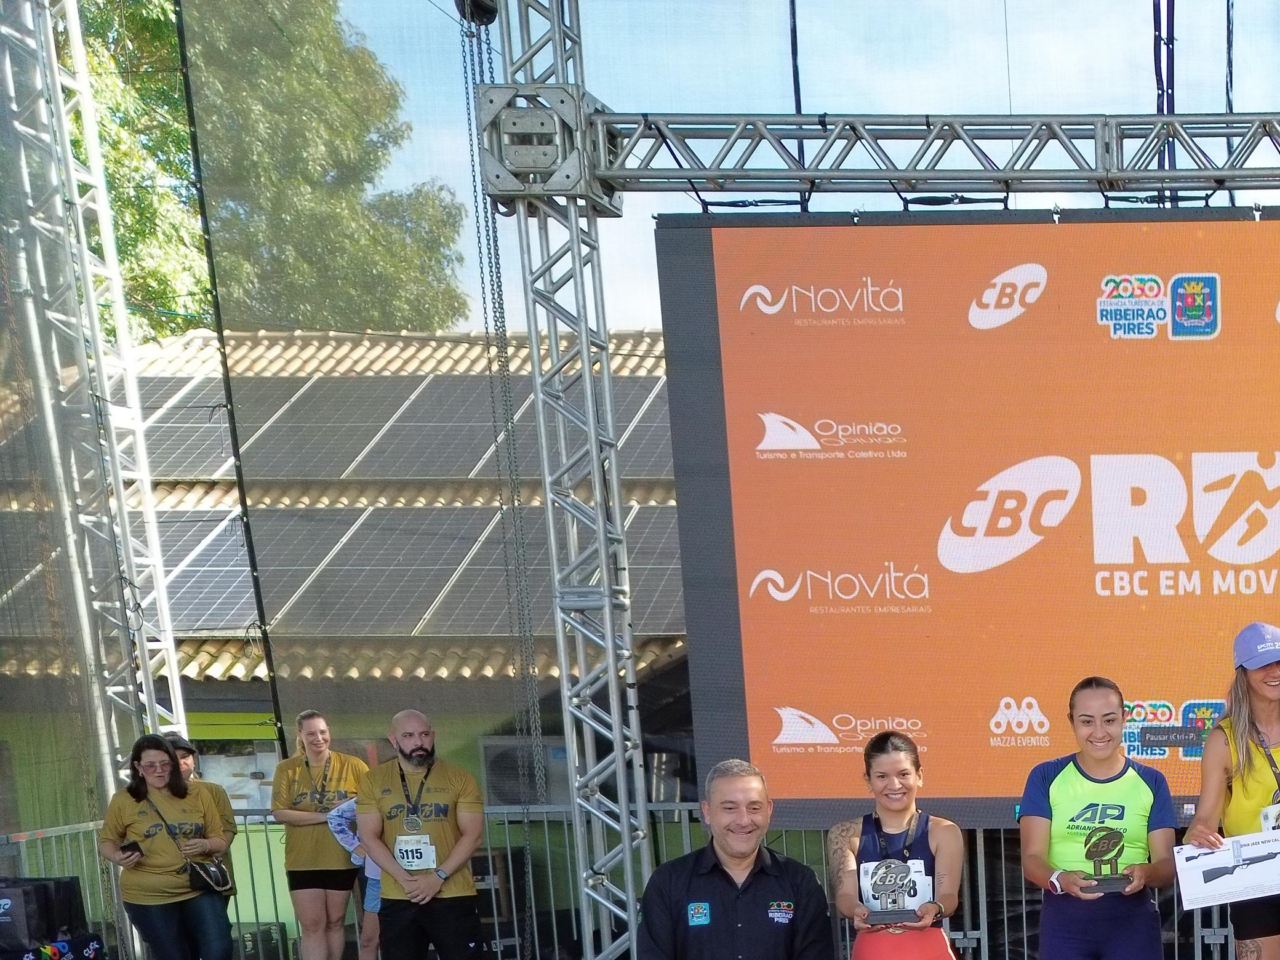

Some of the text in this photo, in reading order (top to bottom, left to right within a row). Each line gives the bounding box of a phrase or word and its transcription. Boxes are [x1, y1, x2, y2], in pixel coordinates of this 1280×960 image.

[792, 277, 903, 313] Novitá
[795, 317, 906, 327] RESTAURANTES EMPRESARIAIS
[1113, 322, 1154, 335] PIRES
[814, 418, 902, 440] Opinião
[755, 451, 788, 460] Turismo
[799, 451, 845, 460] Transporte
[847, 450, 884, 459] Coletivo
[886, 450, 907, 458] Ltda
[806, 561, 930, 600] Novitá
[1095, 570, 1149, 596] CBC
[1159, 569, 1201, 595] EM
[809, 605, 932, 614] RESTAURANTES EMPRESARIAIS
[832, 713, 922, 736] Opinião
[990, 735, 1050, 747] MAZZA EVENTOS
[1145, 733, 1168, 741] Pausar
[1169, 733, 1197, 742] (Ctrl+P)
[772, 746, 805, 754] Turismo
[1068, 803, 1126, 825] AP
[1066, 824, 1097, 833] ADRIANO
[1089, 839, 1119, 852] CBC
[399, 848, 423, 860] 5115
[876, 873, 907, 885] CBC
